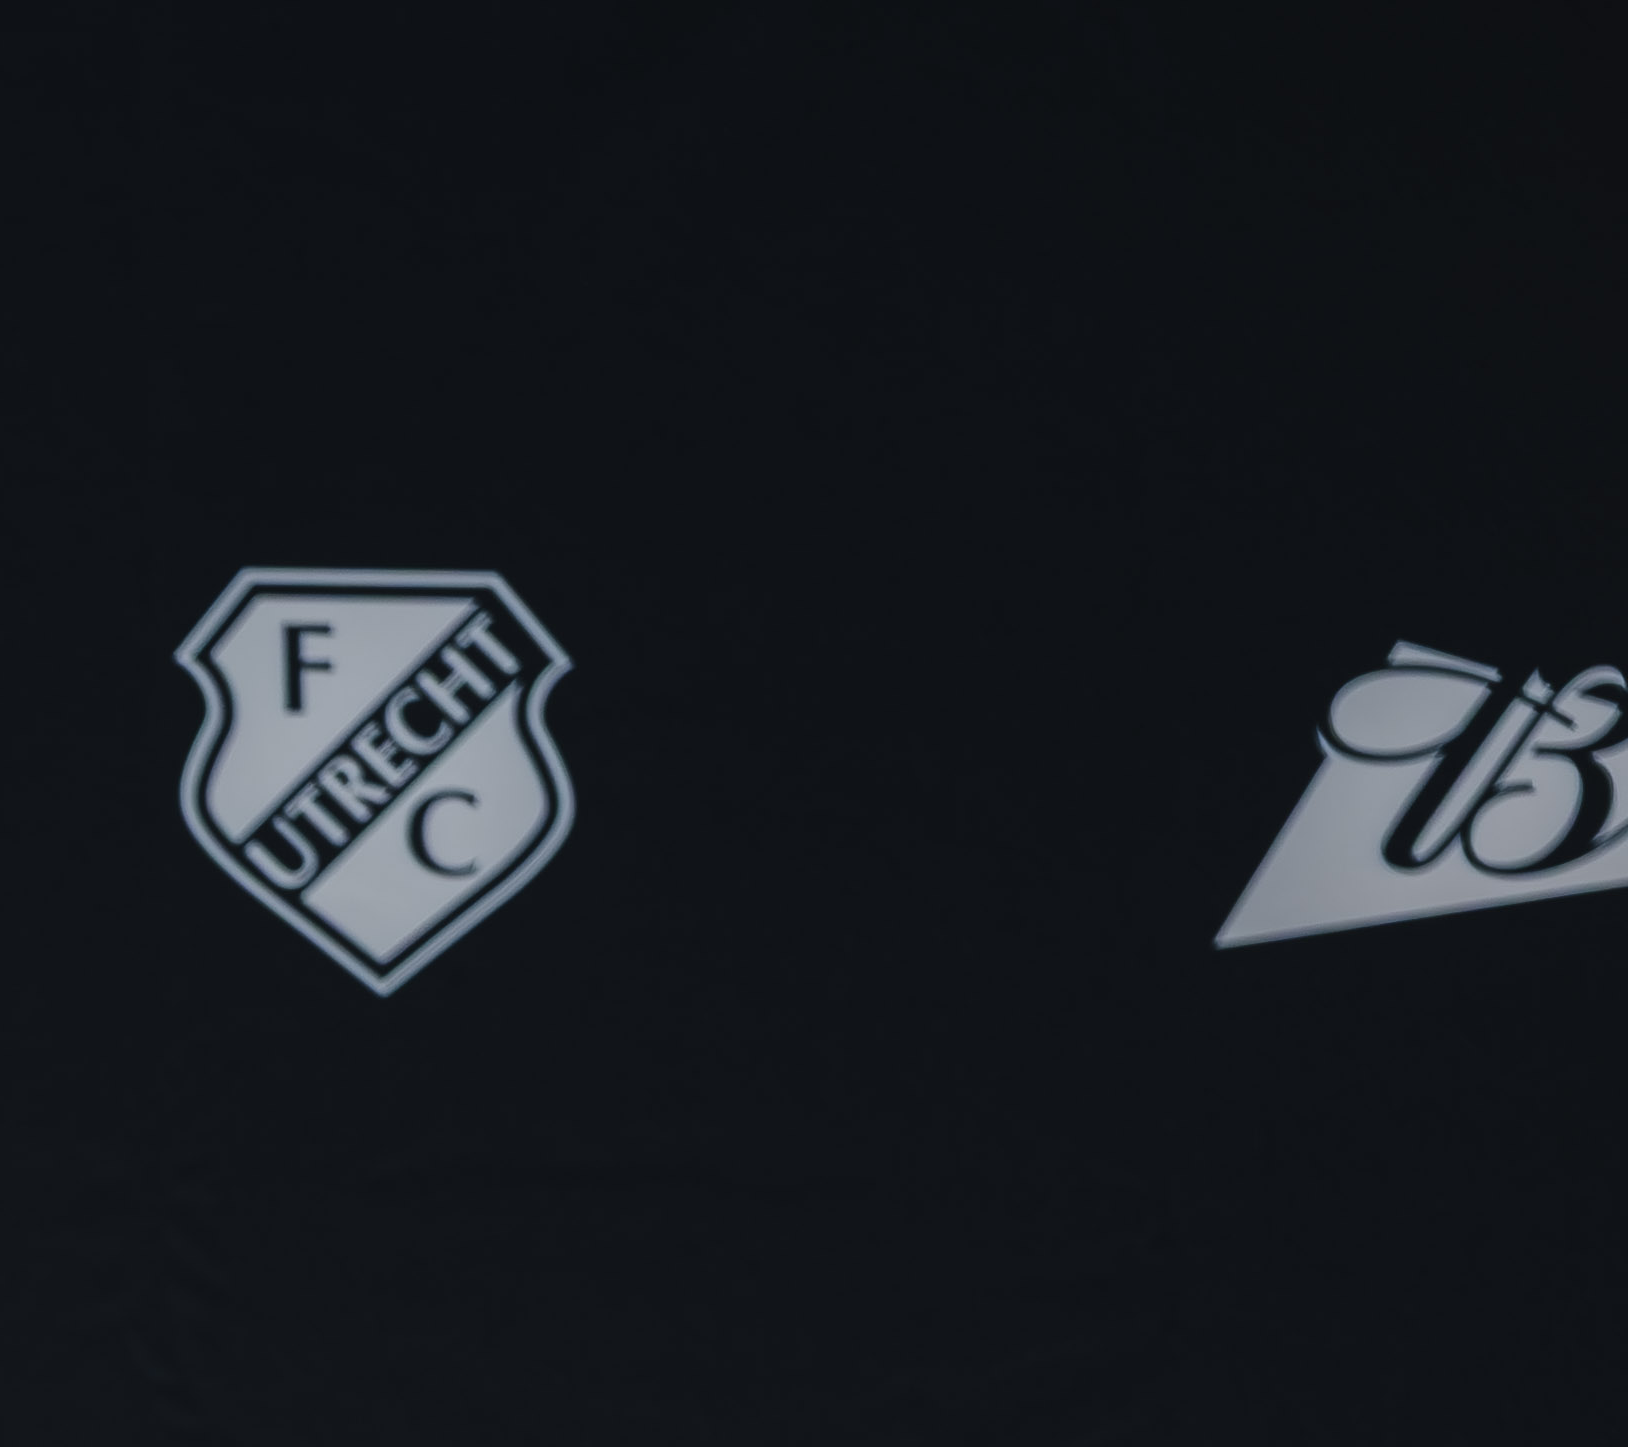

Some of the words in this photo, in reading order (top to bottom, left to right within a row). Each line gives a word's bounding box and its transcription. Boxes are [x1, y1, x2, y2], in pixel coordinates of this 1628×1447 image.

[281, 622, 335, 714] F
[242, 610, 521, 891] UTRECHT
[405, 789, 479, 879] C
